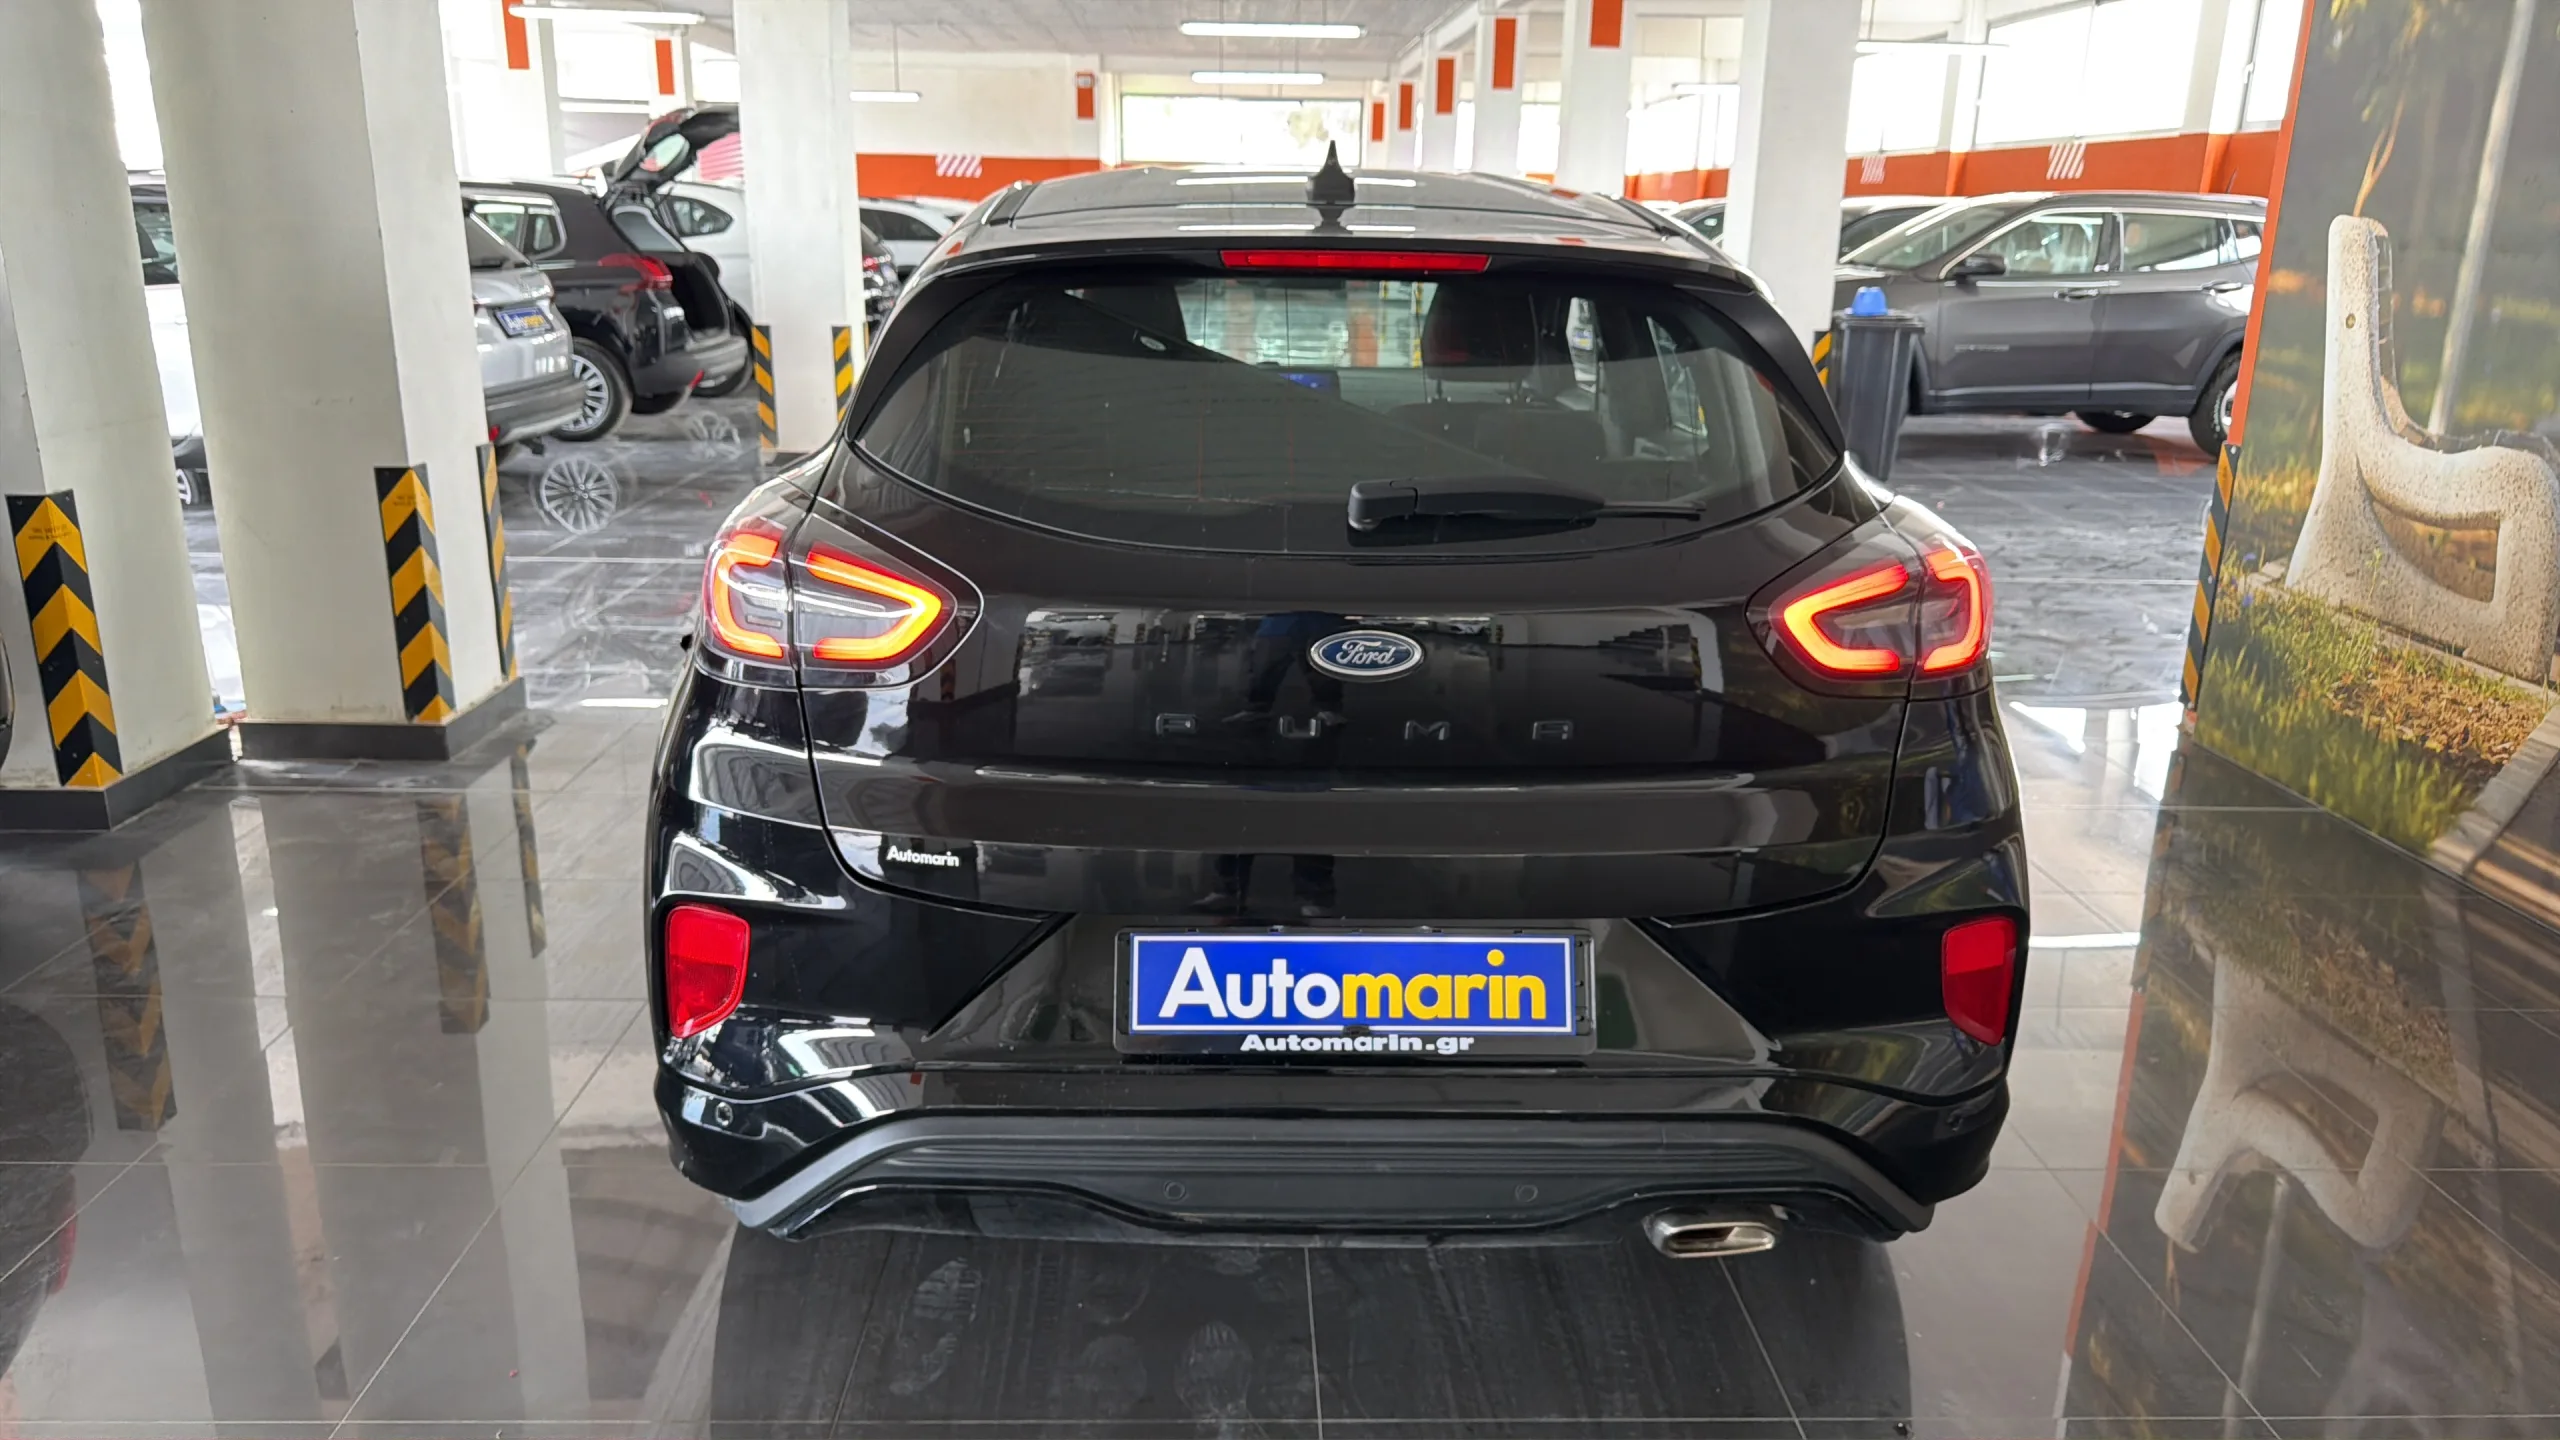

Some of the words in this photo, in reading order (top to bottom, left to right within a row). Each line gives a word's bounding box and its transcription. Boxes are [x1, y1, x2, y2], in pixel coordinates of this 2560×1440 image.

[1336, 639, 1397, 665] Ford
[1156, 712, 1573, 740] PUMA
[886, 845, 960, 867] Automarin
[1158, 946, 1546, 1020] Automarin
[1240, 1034, 1474, 1055] Automarin.gr
